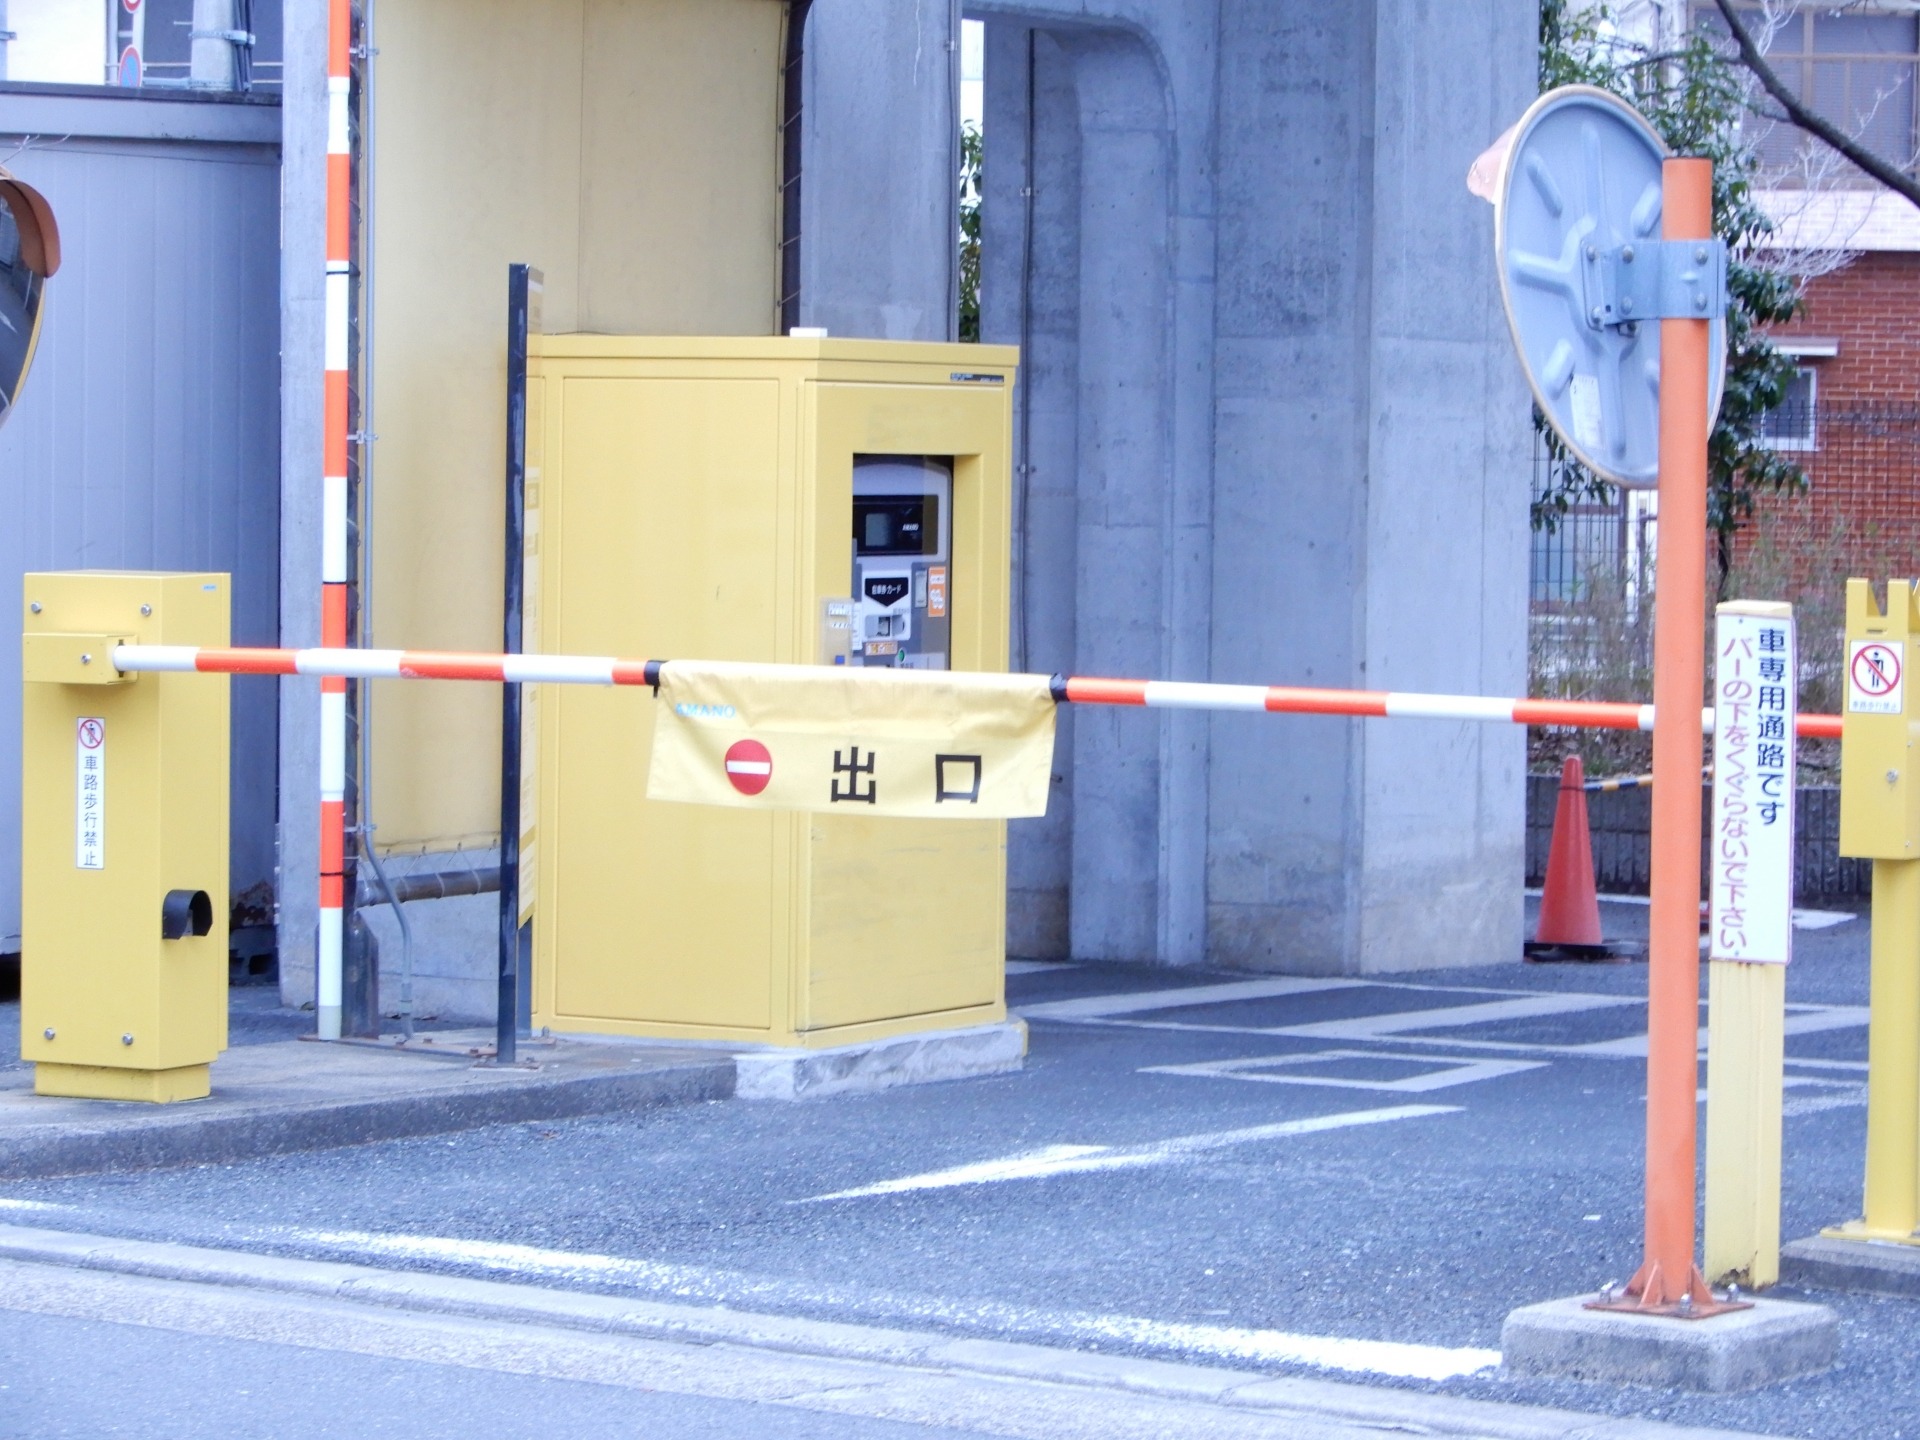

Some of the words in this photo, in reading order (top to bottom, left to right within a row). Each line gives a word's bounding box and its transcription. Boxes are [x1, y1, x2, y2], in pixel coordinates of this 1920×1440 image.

[675, 702, 736, 718] AMANO
[1757, 628, 1786, 825] 車専用通路です
[83, 755, 98, 867] 車路歩行禁止
[831, 746, 982, 804] 出口
[1721, 637, 1753, 949] バーの下をくぐらないで下さい
